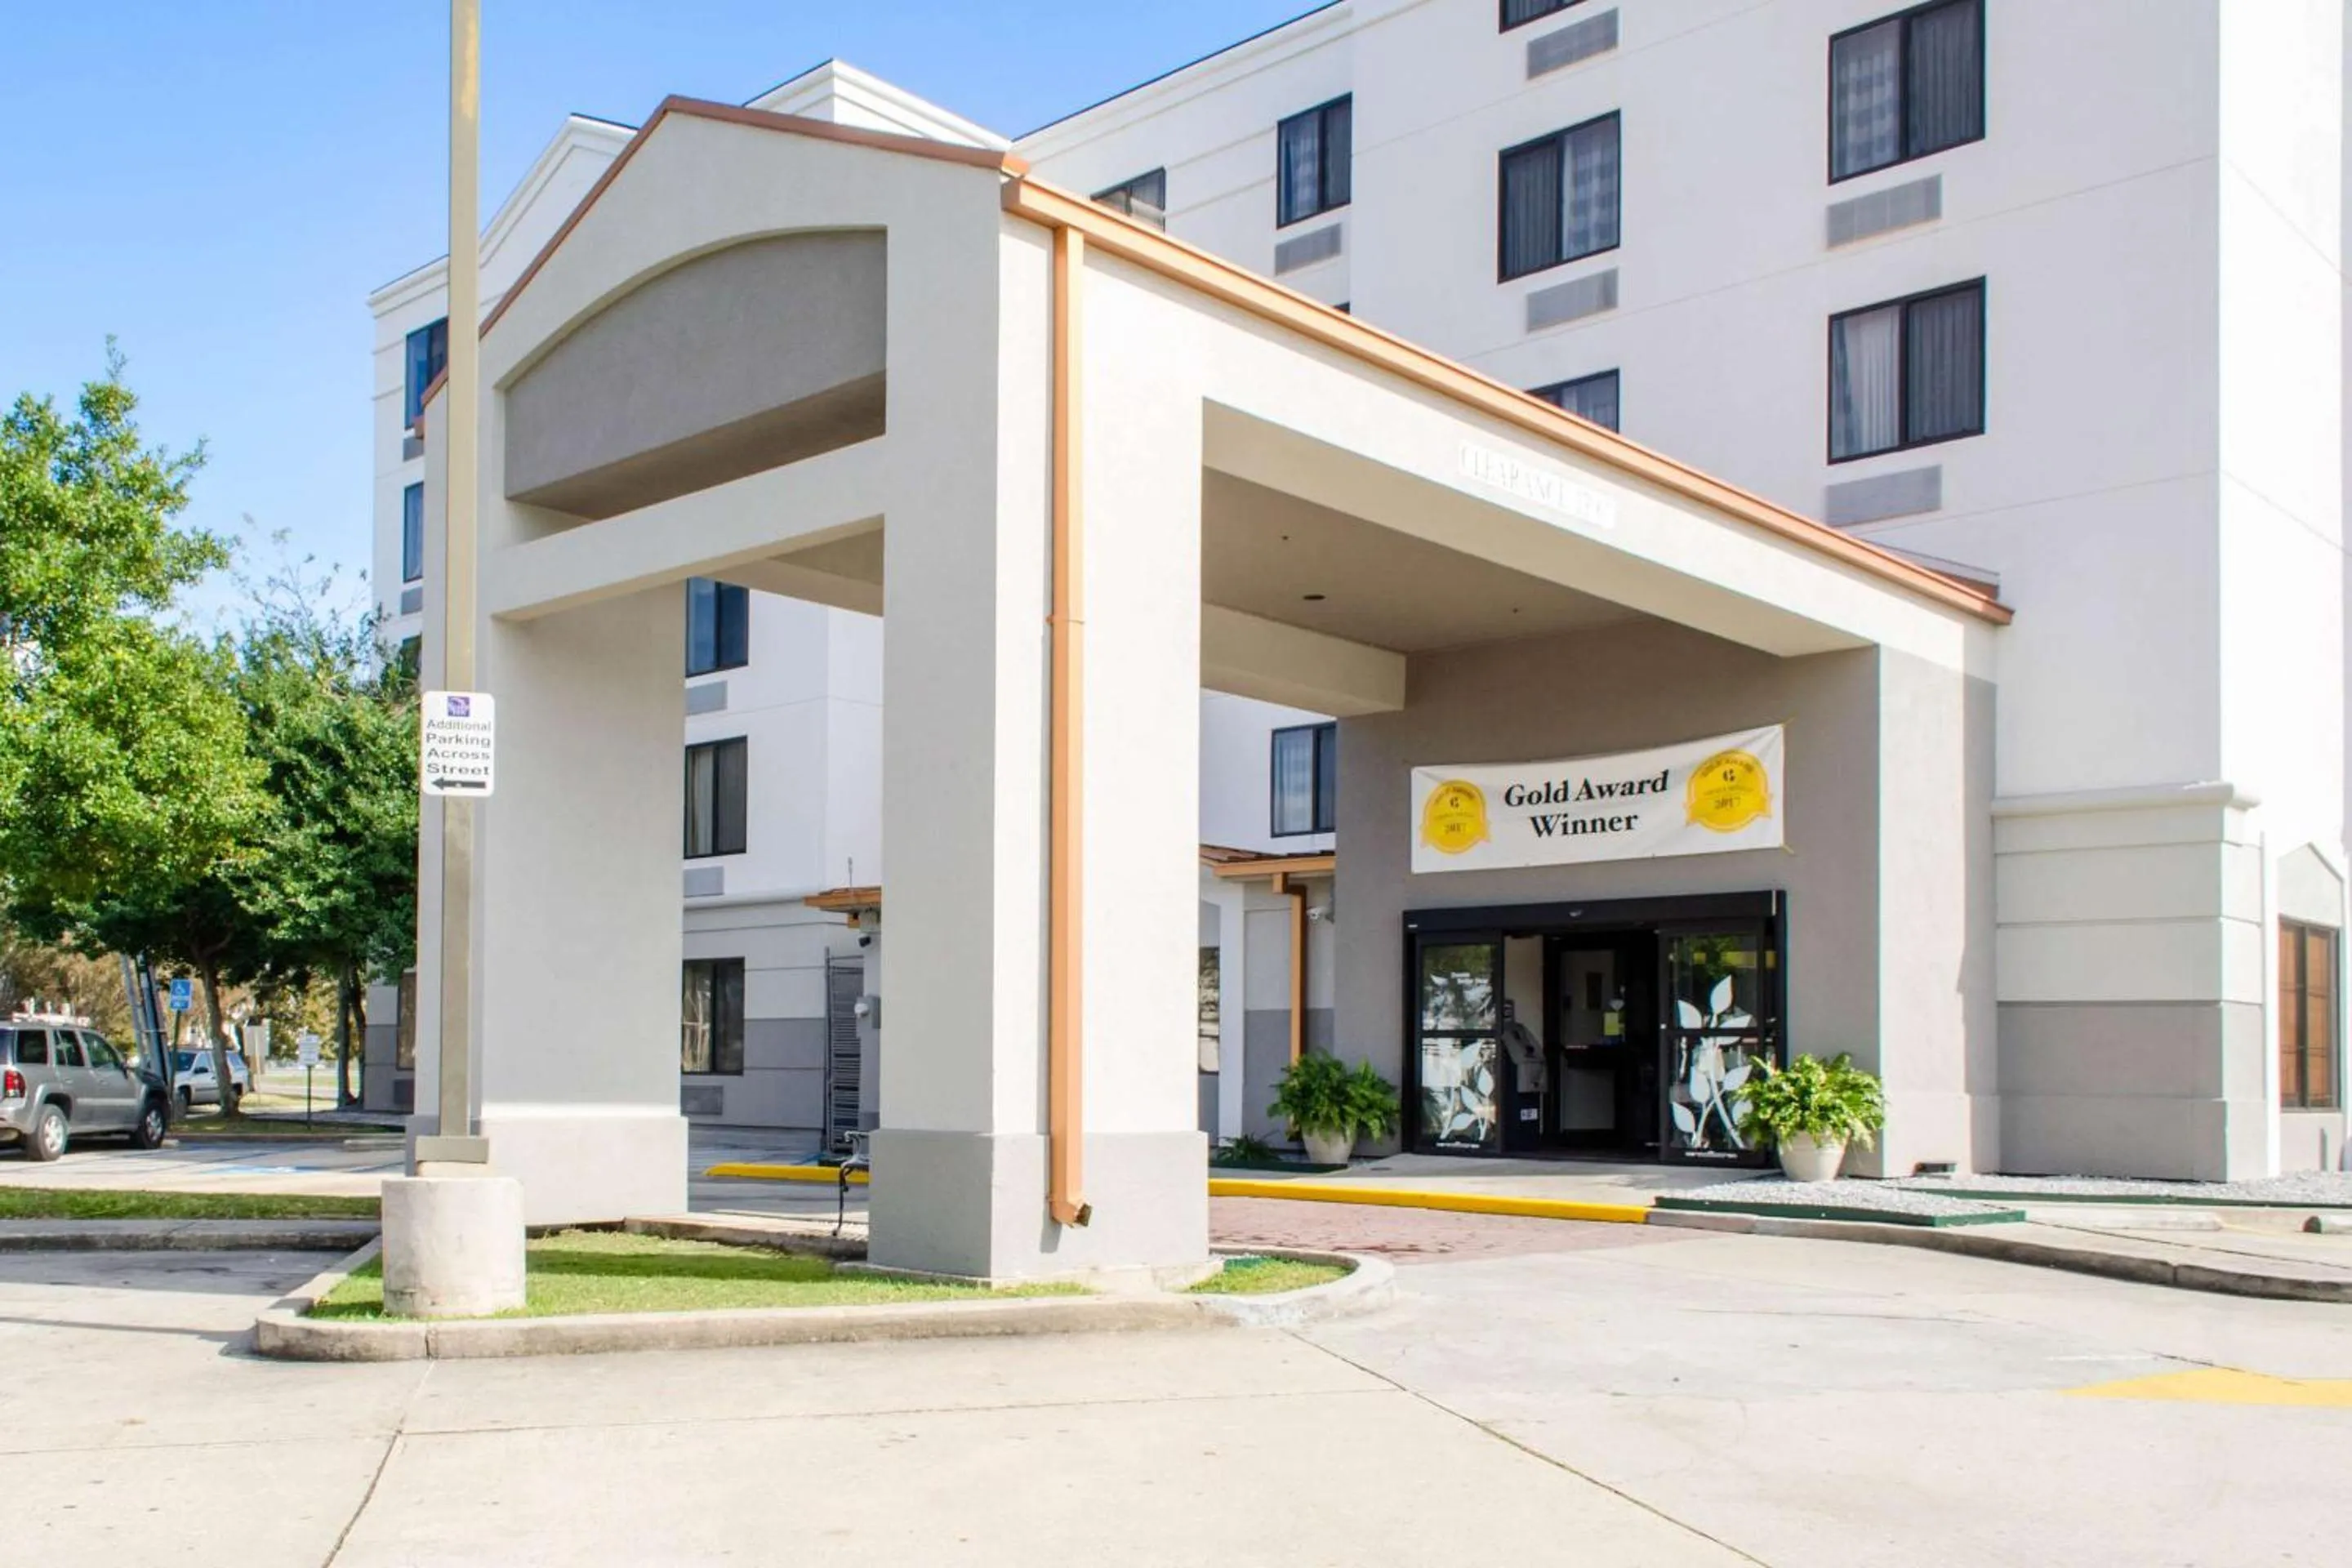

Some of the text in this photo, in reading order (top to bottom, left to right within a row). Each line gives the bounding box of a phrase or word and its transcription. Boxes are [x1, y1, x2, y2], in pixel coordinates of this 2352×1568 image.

[426, 719, 492, 732] Additional
[425, 733, 491, 748] Parking
[427, 748, 490, 760] Across
[426, 763, 489, 775] Street
[1504, 780, 1569, 808] Gold
[1575, 769, 1670, 802] Award
[1529, 813, 1639, 838] Winner
